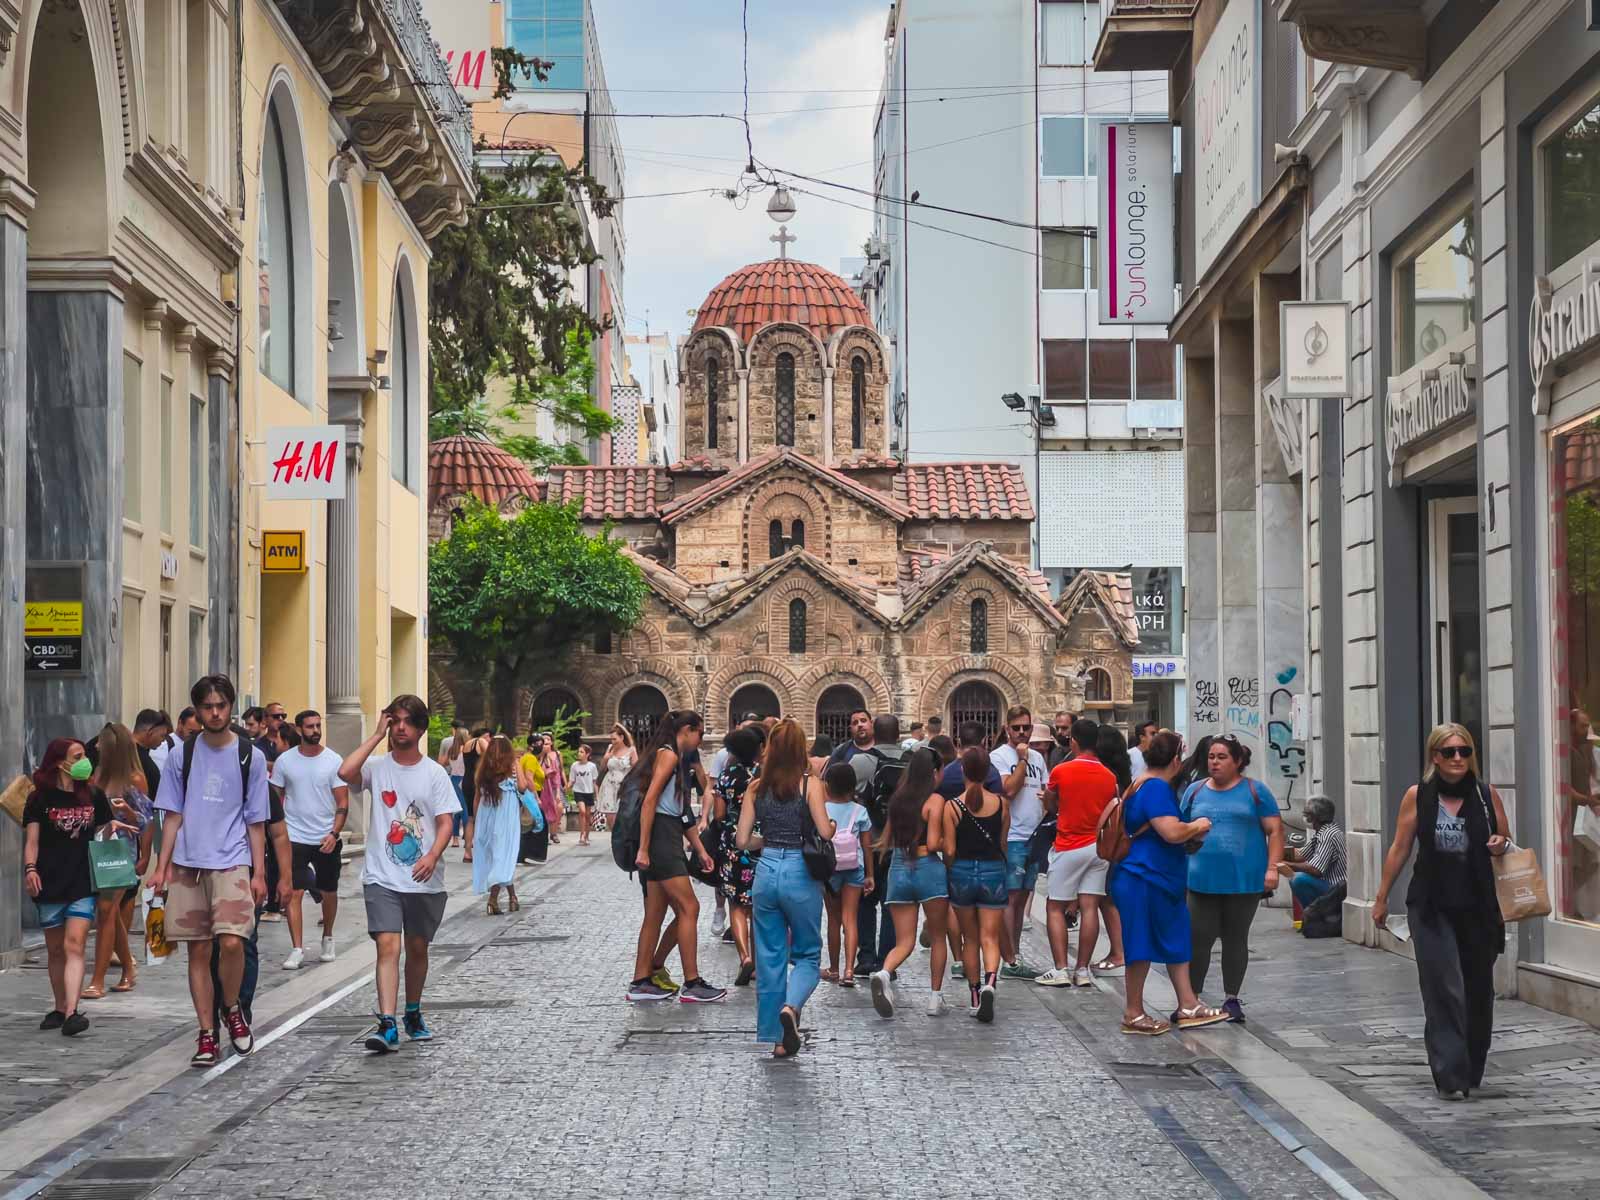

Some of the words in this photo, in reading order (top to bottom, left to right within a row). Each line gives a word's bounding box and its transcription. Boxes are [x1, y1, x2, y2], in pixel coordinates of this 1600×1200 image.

[1127, 124, 1137, 182] solarium
[272, 440, 338, 484] H&M
[267, 545, 298, 557] ATM
[1135, 590, 1165, 607] ικά
[1131, 662, 1176, 678] SHOP
